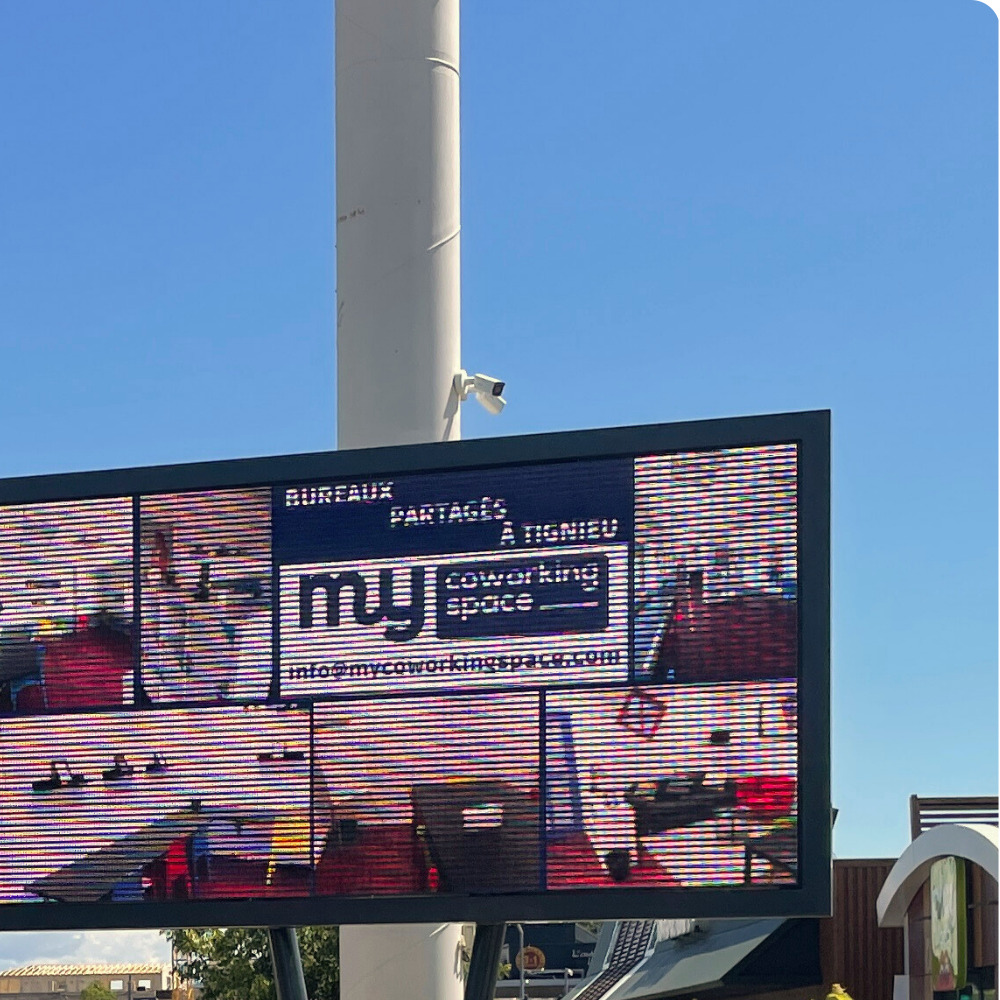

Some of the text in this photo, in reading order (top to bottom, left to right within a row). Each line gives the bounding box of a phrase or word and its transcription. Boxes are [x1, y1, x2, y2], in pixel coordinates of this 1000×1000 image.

[285, 481, 395, 507] BUREAUX
[521, 519, 618, 543] TIGNIEU
[445, 560, 599, 592] coworking
[300, 566, 425, 642] my
[446, 592, 534, 621] space
